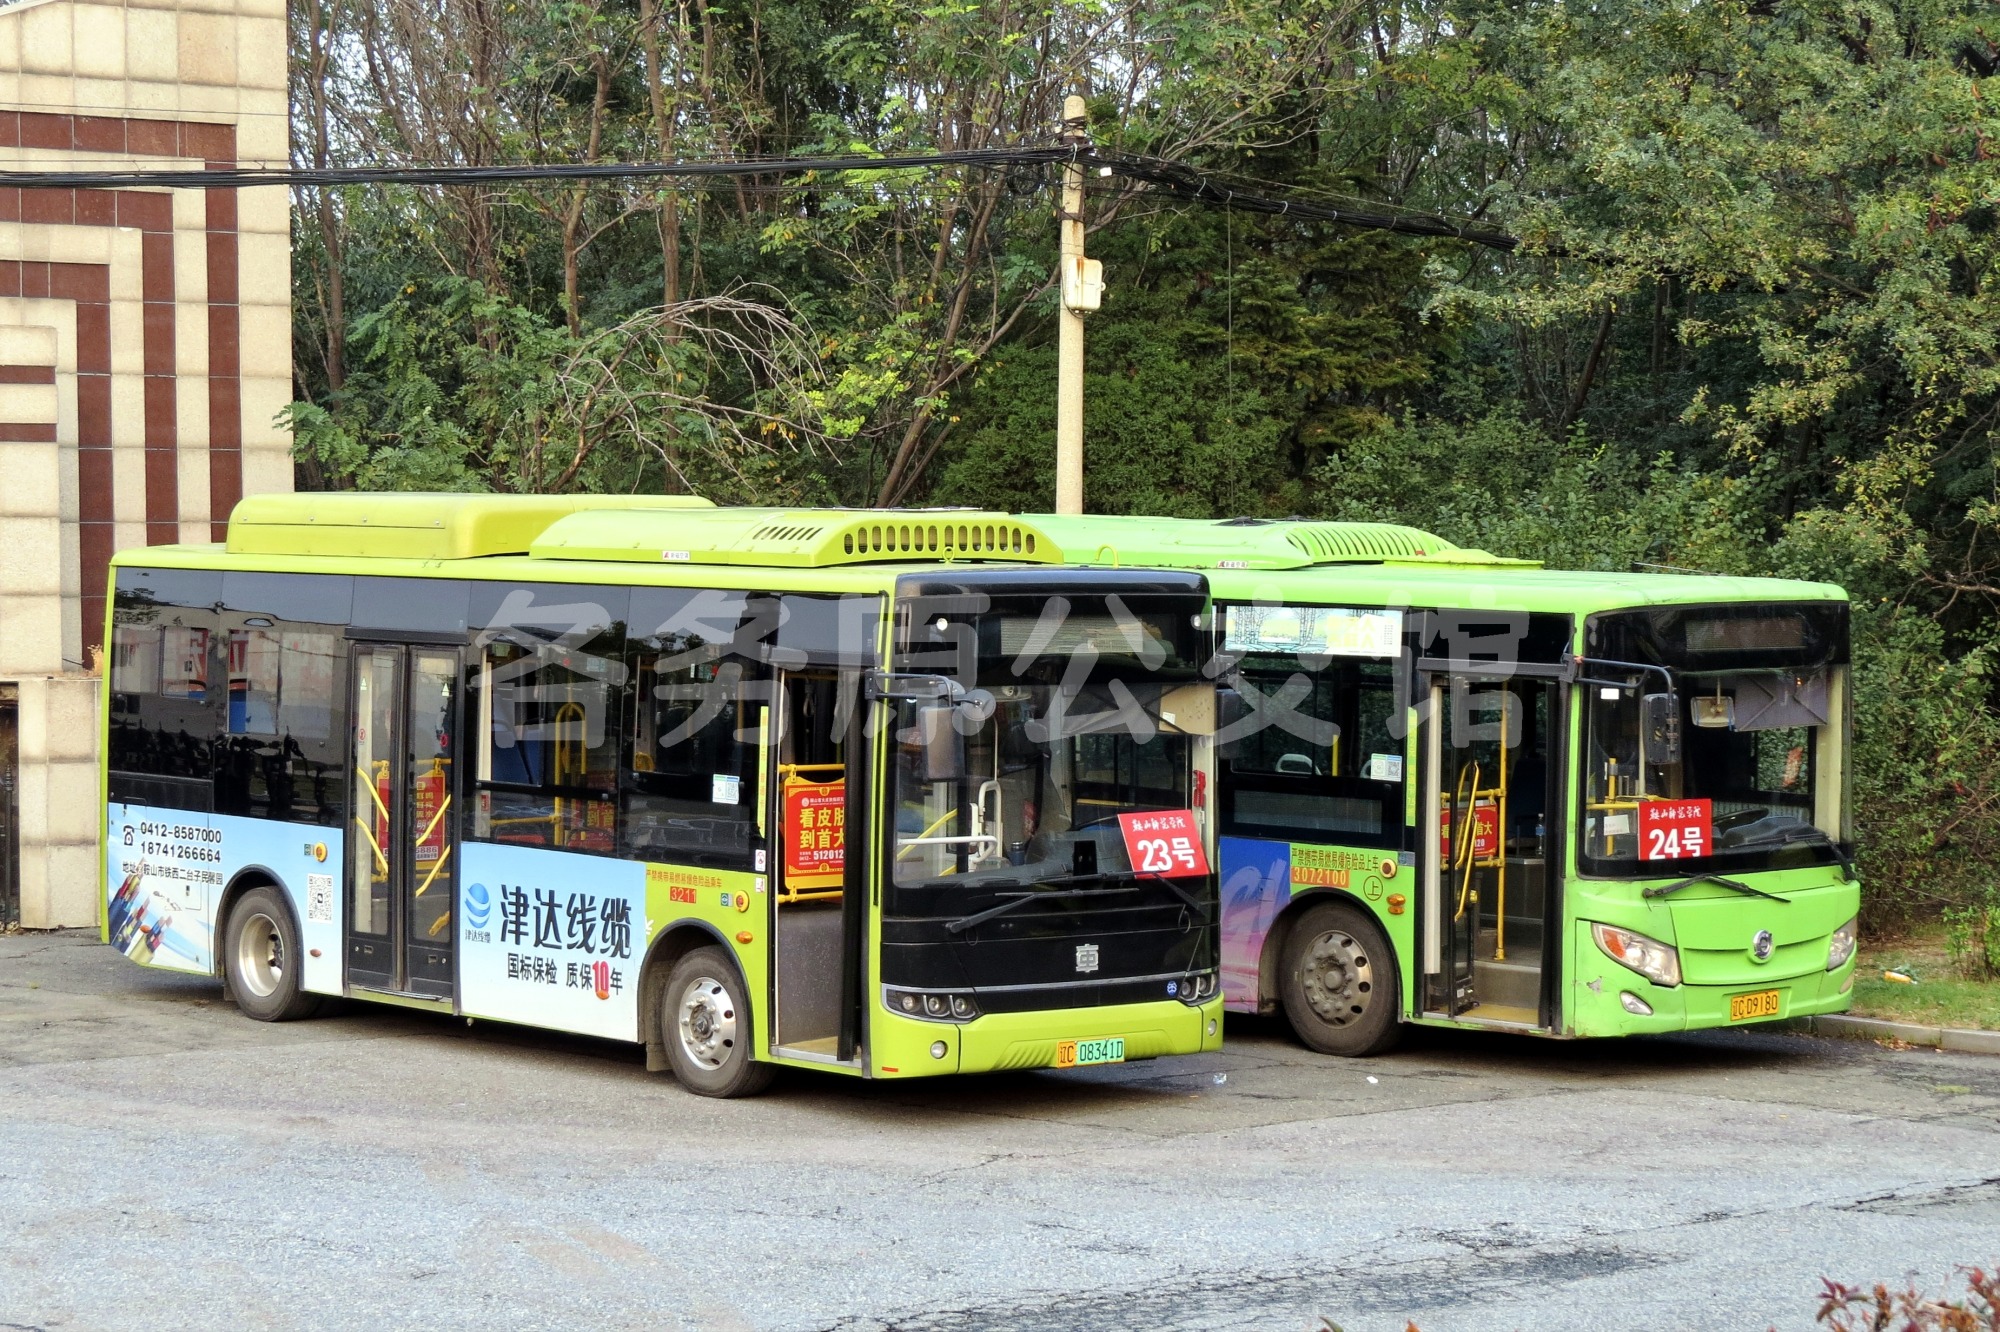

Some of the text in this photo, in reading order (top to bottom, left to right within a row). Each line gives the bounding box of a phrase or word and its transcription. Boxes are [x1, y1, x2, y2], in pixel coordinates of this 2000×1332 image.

[140, 822, 222, 843] 0412-8587000
[1649, 827, 1704, 860] 24号
[140, 841, 221, 863] 18741266664
[1137, 837, 1195, 872] 23号
[1293, 866, 1347, 885] 3072100
[500, 884, 632, 959] 津达线缆
[508, 953, 558, 985] 国标保检
